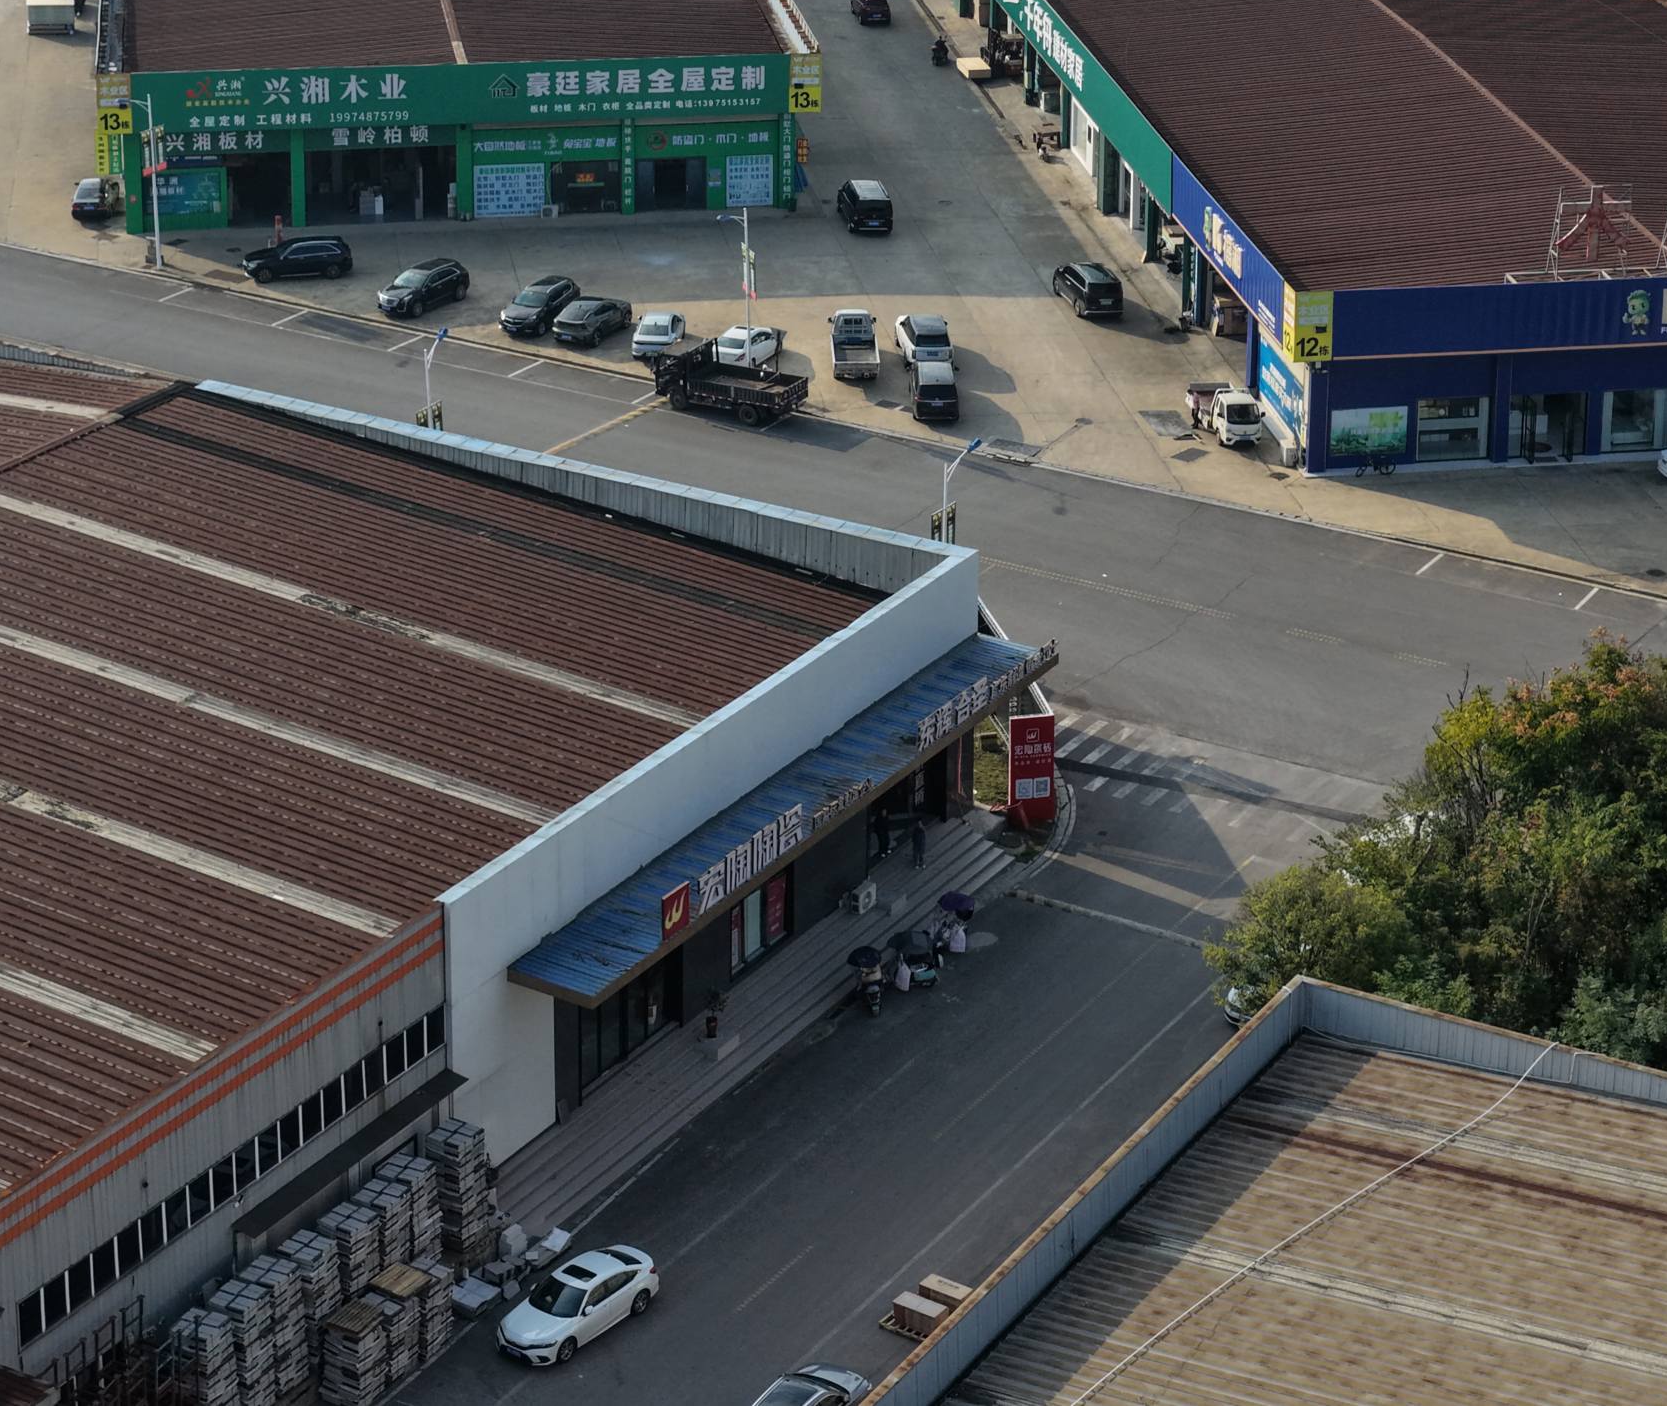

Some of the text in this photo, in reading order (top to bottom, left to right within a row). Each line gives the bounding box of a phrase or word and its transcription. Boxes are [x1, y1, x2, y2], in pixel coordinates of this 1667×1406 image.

[262, 74, 407, 105] 兴湘木业
[526, 66, 766, 97] 豪廷家居全屋定制
[530, 105, 548, 113] 板材
[579, 102, 596, 111] 木门
[790, 92, 819, 108] 13栋
[99, 113, 130, 130] 13栋
[189, 111, 409, 127] 全屋定制 工程材料 19974875799
[166, 131, 265, 152] 兴湘板材
